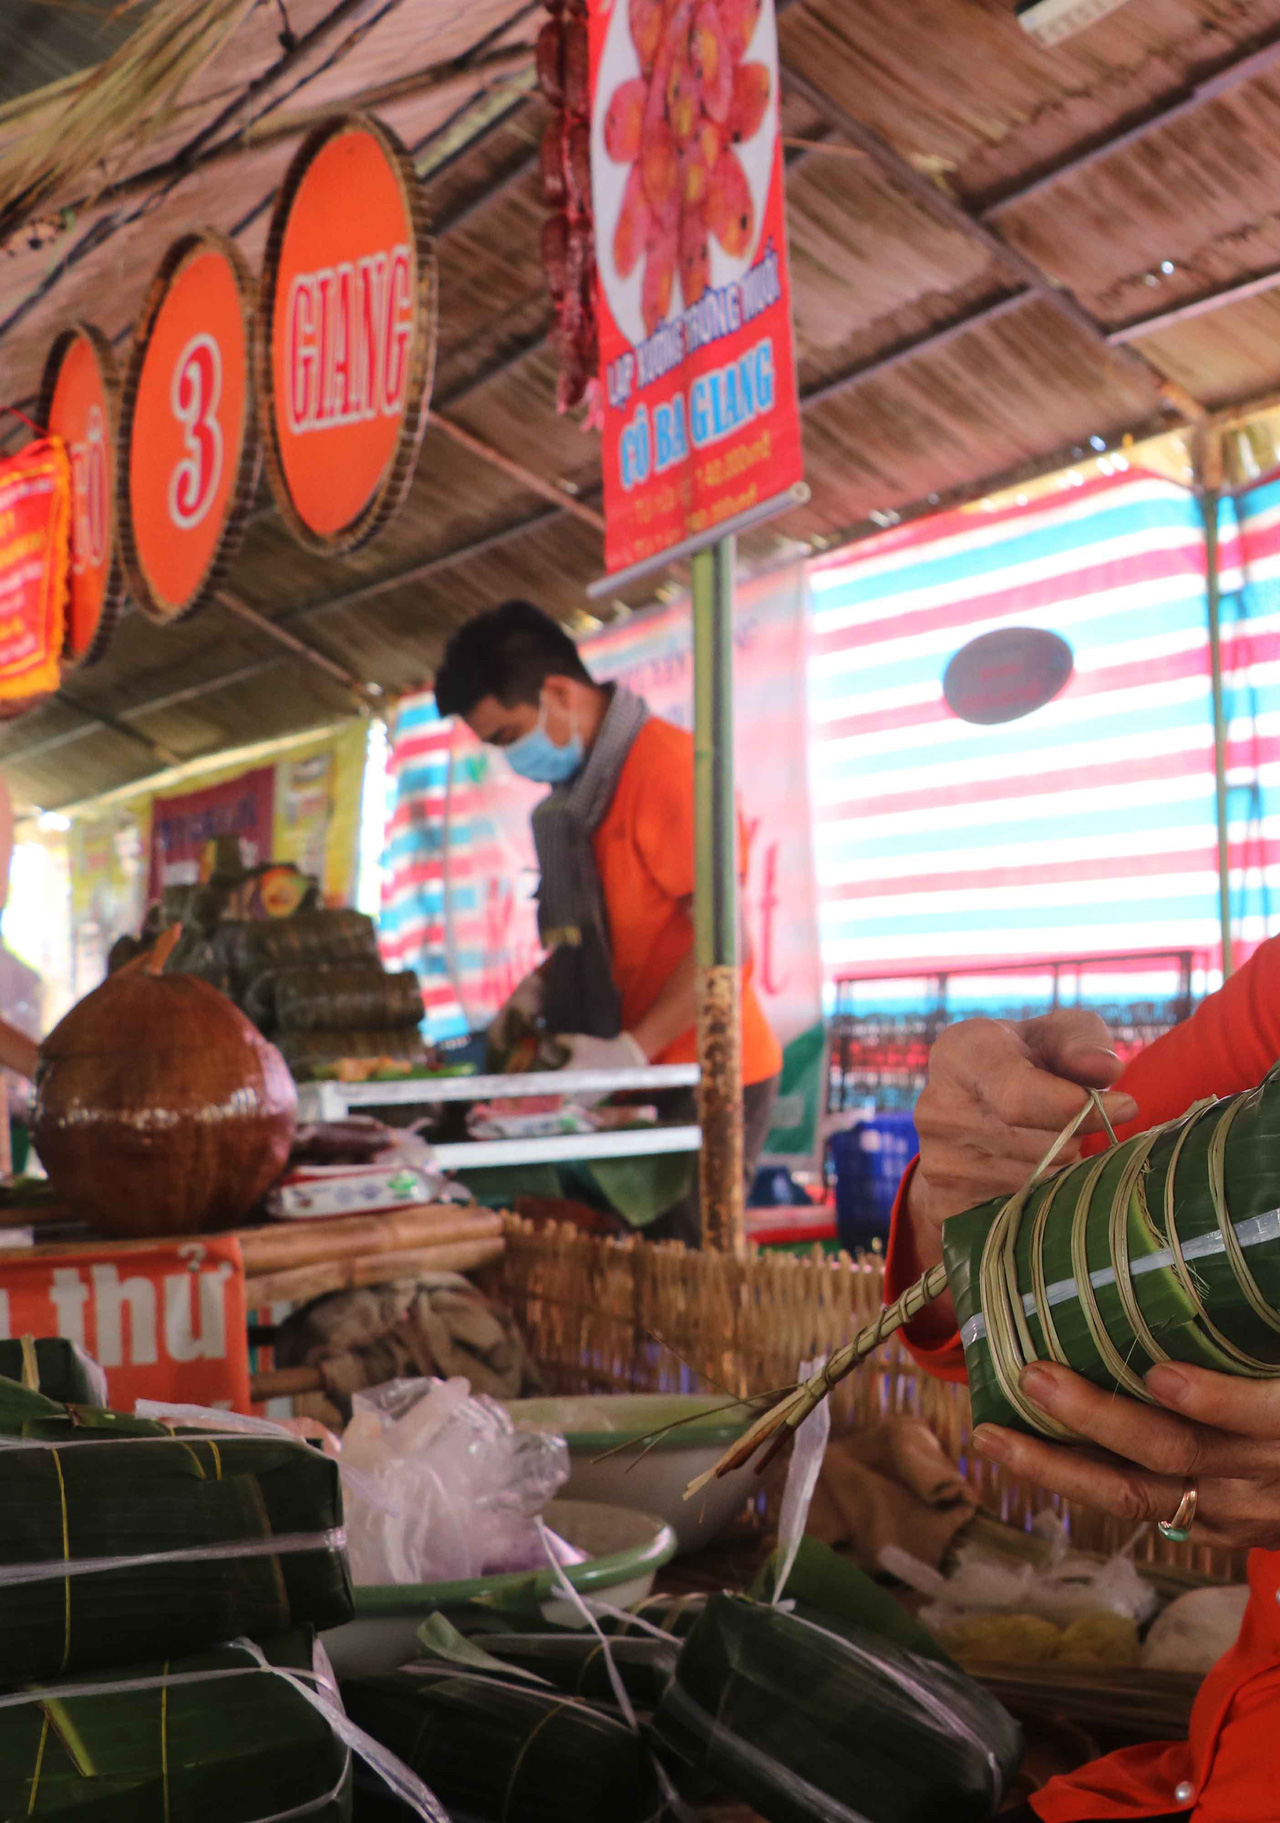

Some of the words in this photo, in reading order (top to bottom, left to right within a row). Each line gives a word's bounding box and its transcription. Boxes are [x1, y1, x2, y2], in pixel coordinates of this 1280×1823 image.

[287, 245, 414, 434] GIANG
[620, 402, 652, 492] CÔ
[652, 393, 690, 473] BA
[688, 336, 775, 449] GIANG
[168, 333, 224, 529] 3
[49, 1242, 233, 1368] thử
